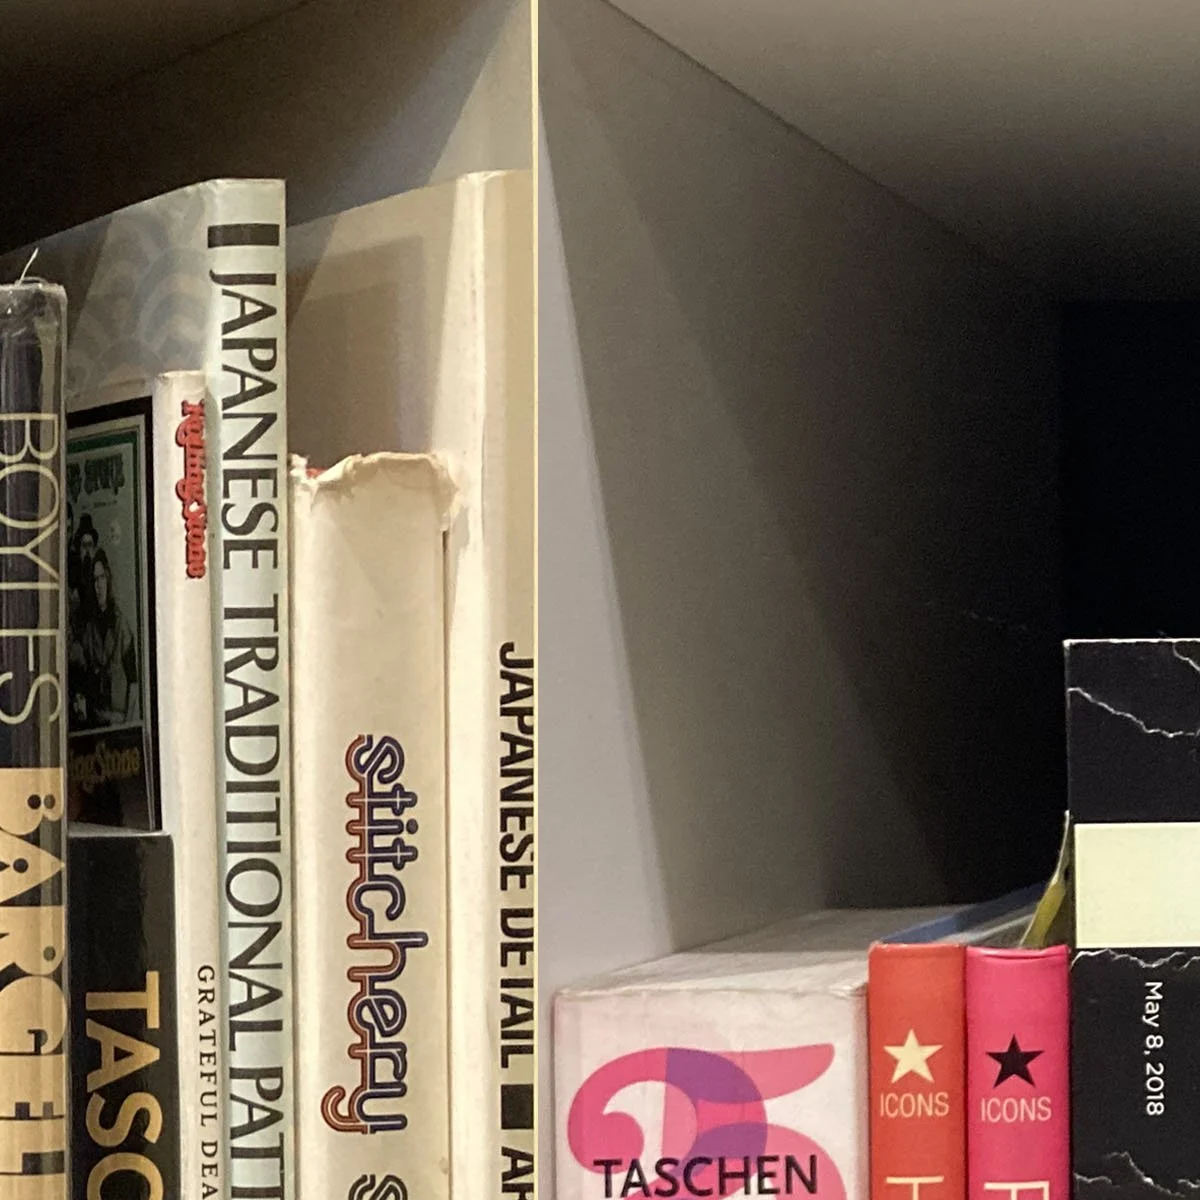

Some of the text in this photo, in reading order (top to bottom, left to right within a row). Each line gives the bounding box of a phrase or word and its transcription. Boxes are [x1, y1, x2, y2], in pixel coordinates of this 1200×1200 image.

[209, 269, 280, 571] JAPANESE
[221, 594, 284, 1052] TRADITIONAL
[499, 641, 535, 892] JAPANESE
[197, 964, 220, 1128] GRATEFUL
[500, 908, 536, 1069] DETAIL
[1142, 980, 1165, 1117] May 8, 2018
[593, 1154, 819, 1199] TASCHEN
[879, 1091, 950, 1119] ICONS
[980, 1095, 1053, 1123] ICONS
